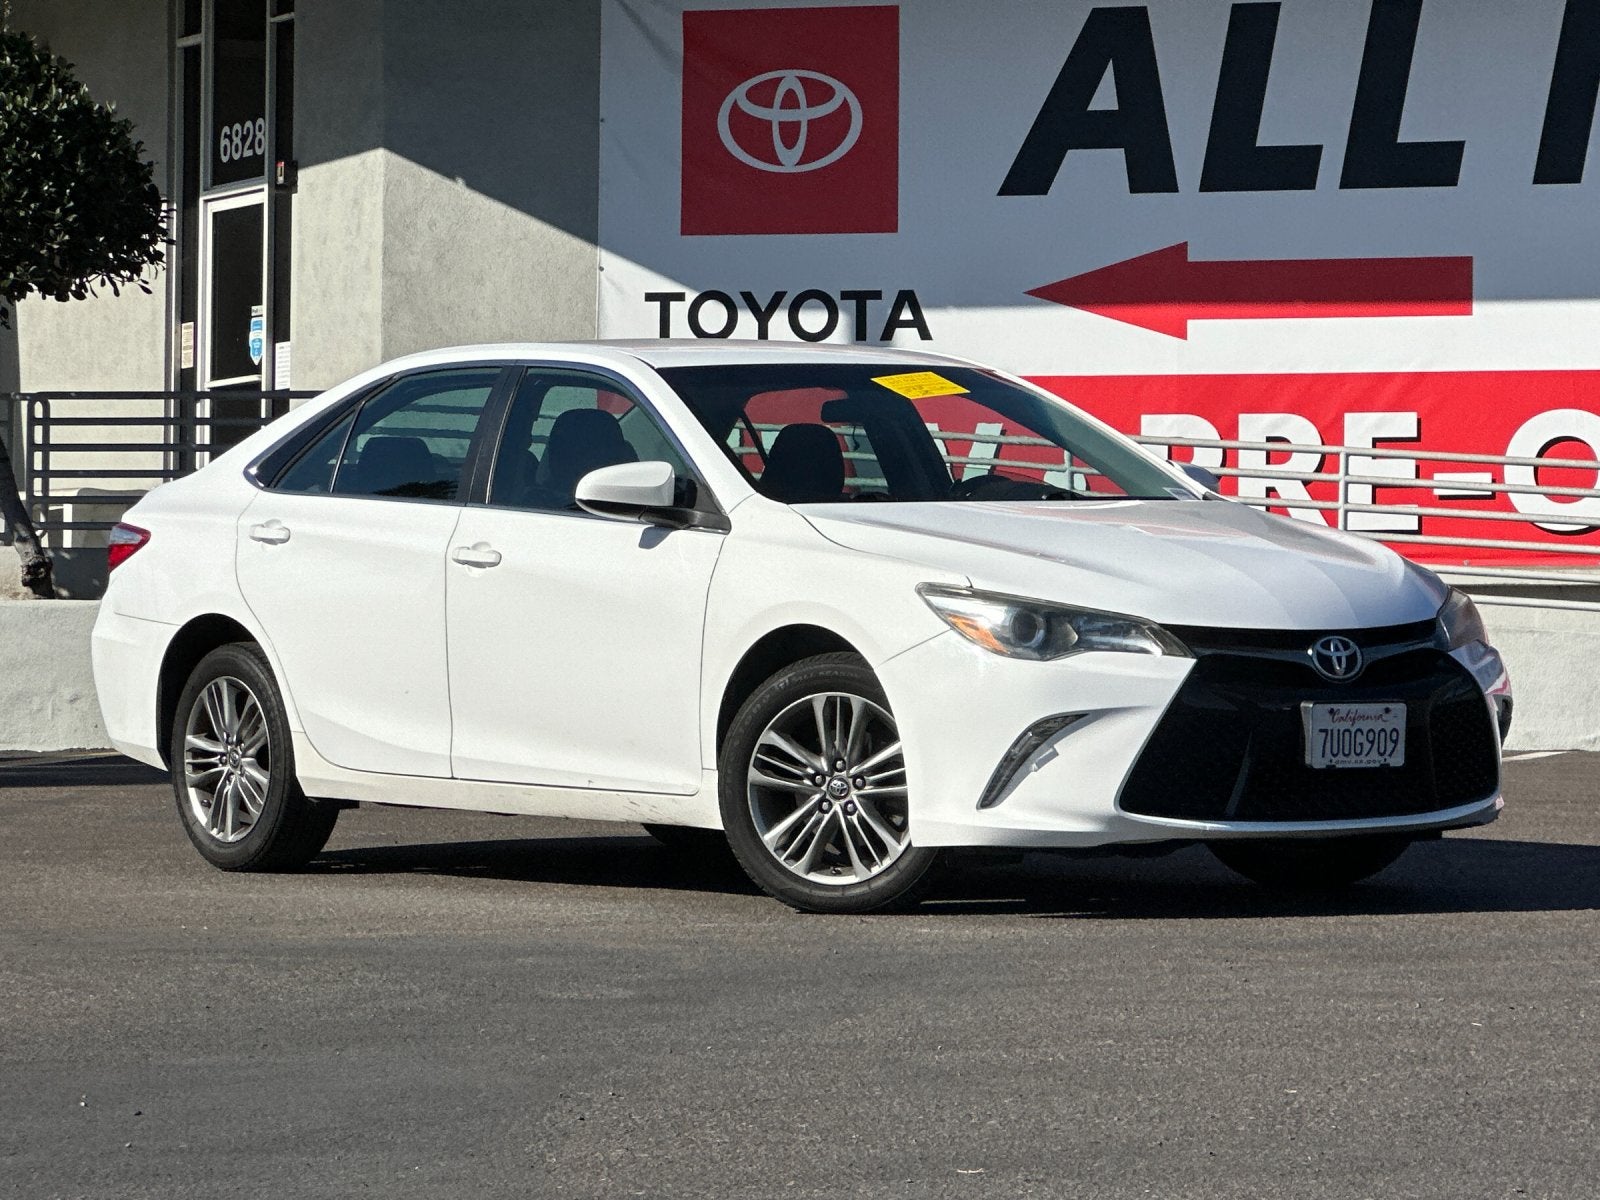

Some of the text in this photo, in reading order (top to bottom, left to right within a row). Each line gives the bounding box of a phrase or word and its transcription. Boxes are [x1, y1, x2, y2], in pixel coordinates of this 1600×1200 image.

[997, 0, 1465, 195] ALL
[220, 117, 265, 163] 6828
[644, 289, 933, 342] TOYOTA
[1331, 708, 1389, 727] California
